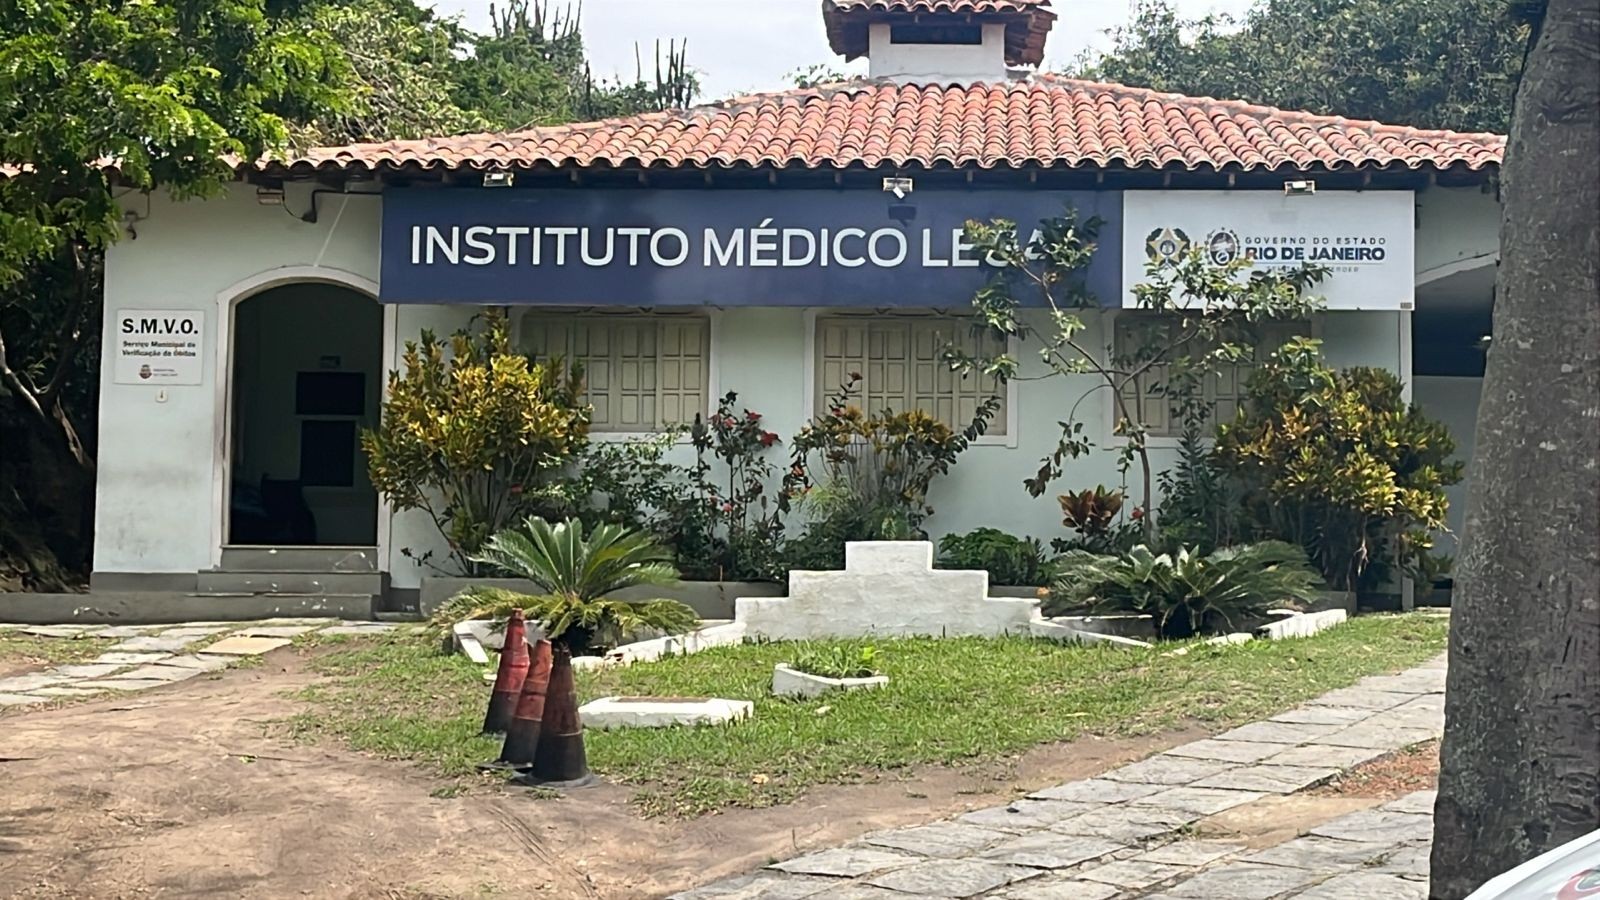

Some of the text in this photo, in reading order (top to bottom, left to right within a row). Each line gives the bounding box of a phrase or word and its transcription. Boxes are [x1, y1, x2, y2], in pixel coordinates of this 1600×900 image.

[411, 225, 689, 267] INSTITUTO
[703, 217, 908, 267] MÉDICO
[1245, 236, 1386, 245] GOVERNO DO ESTADO
[1245, 247, 1385, 261] RIO DE JANEIRO
[121, 318, 199, 335] S.M.V.O.
